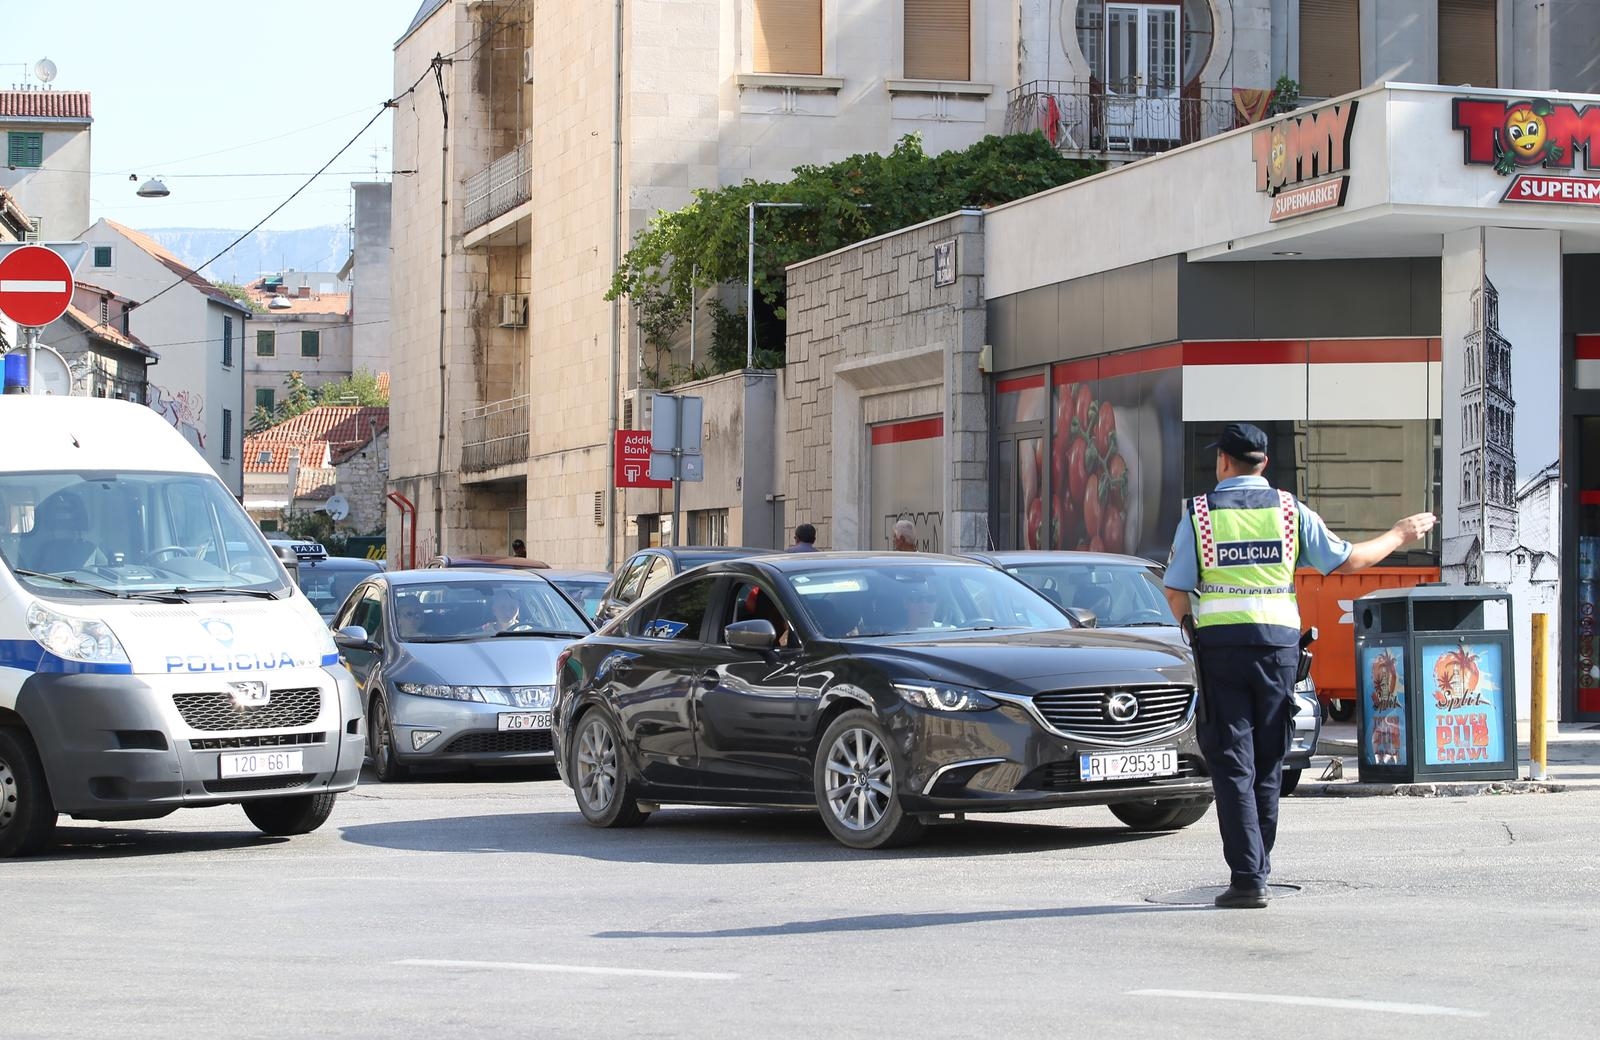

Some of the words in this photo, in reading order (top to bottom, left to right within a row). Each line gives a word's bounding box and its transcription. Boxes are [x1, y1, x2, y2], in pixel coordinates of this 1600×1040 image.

[1275, 183, 1338, 214] SUPERMARKET
[624, 445, 648, 454] Bank
[1219, 546, 1280, 561] POLICIJA
[166, 652, 295, 673] POLICIJA
[508, 715, 522, 729] ZG
[1436, 713, 1487, 726] TOWER
[1436, 725, 1489, 747] PUB
[1437, 747, 1489, 762] CRAWL
[235, 756, 257, 772] 120
[268, 754, 290, 770] 661
[1091, 758, 1107, 775] RI
[1120, 753, 1171, 773] 2953-D
